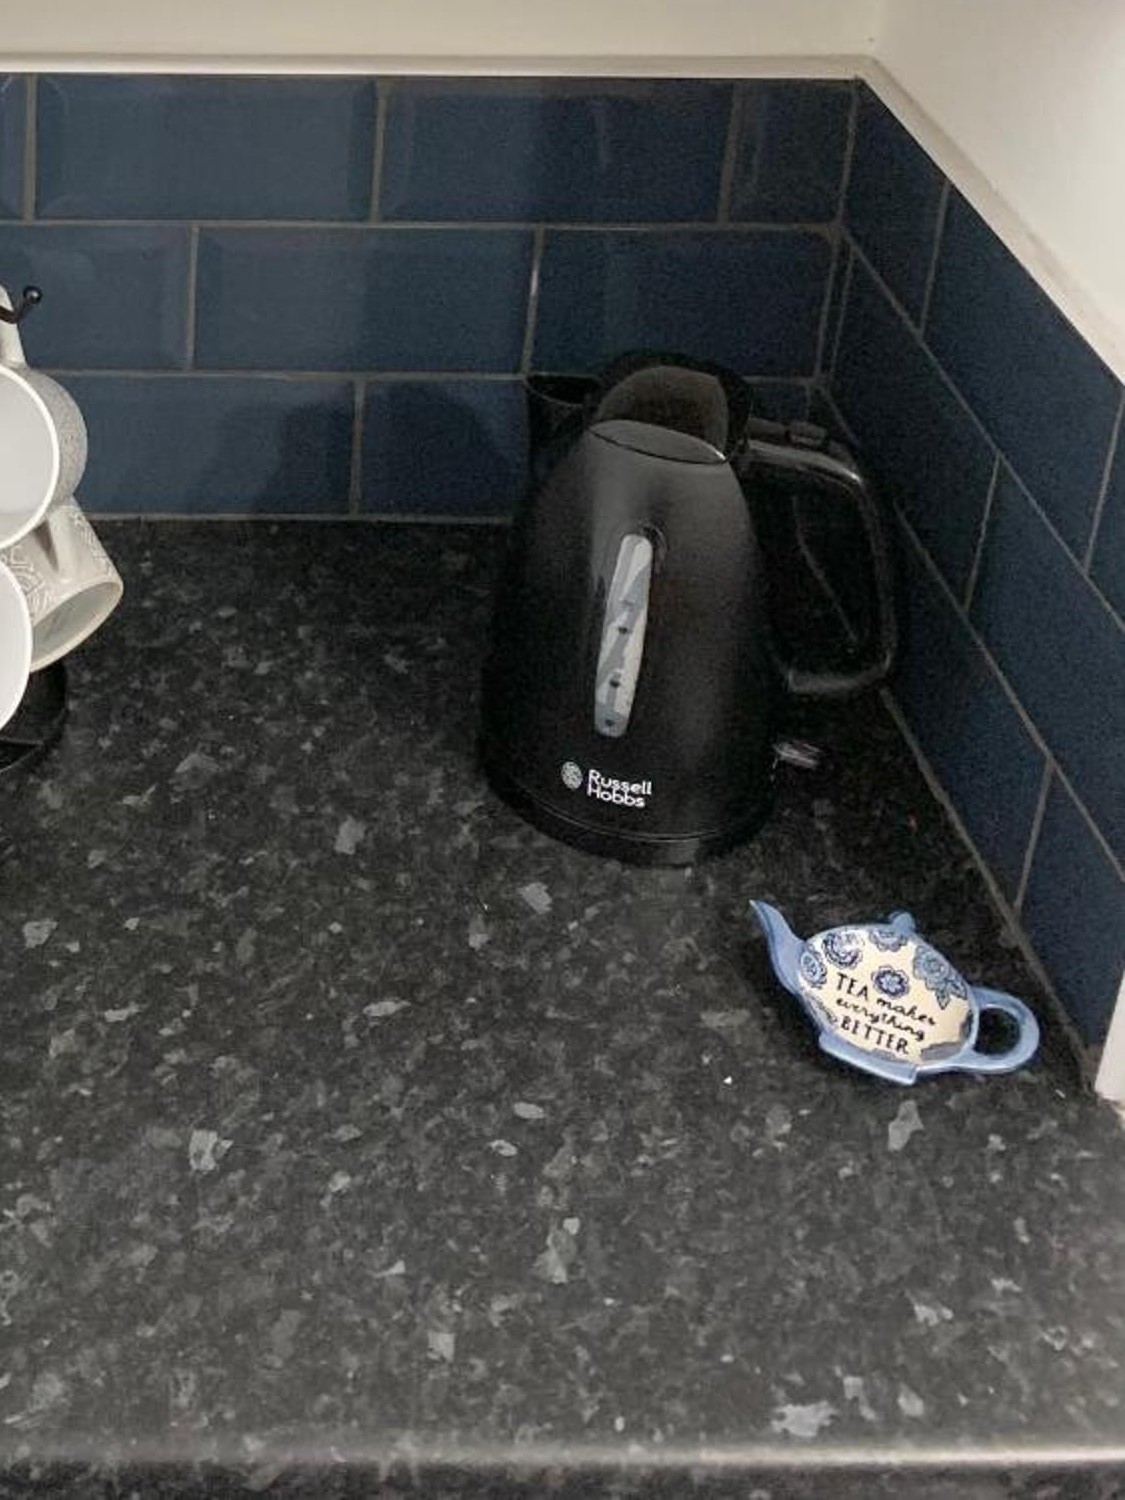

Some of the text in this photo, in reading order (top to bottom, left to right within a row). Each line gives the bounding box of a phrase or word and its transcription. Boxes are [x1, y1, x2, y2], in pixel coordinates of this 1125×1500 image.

[586, 784, 646, 808] Hobbs
[587, 768, 652, 795] Russell
[837, 972, 869, 1002] TEA
[835, 997, 925, 1042] everything
[840, 1015, 909, 1055] BETTER
